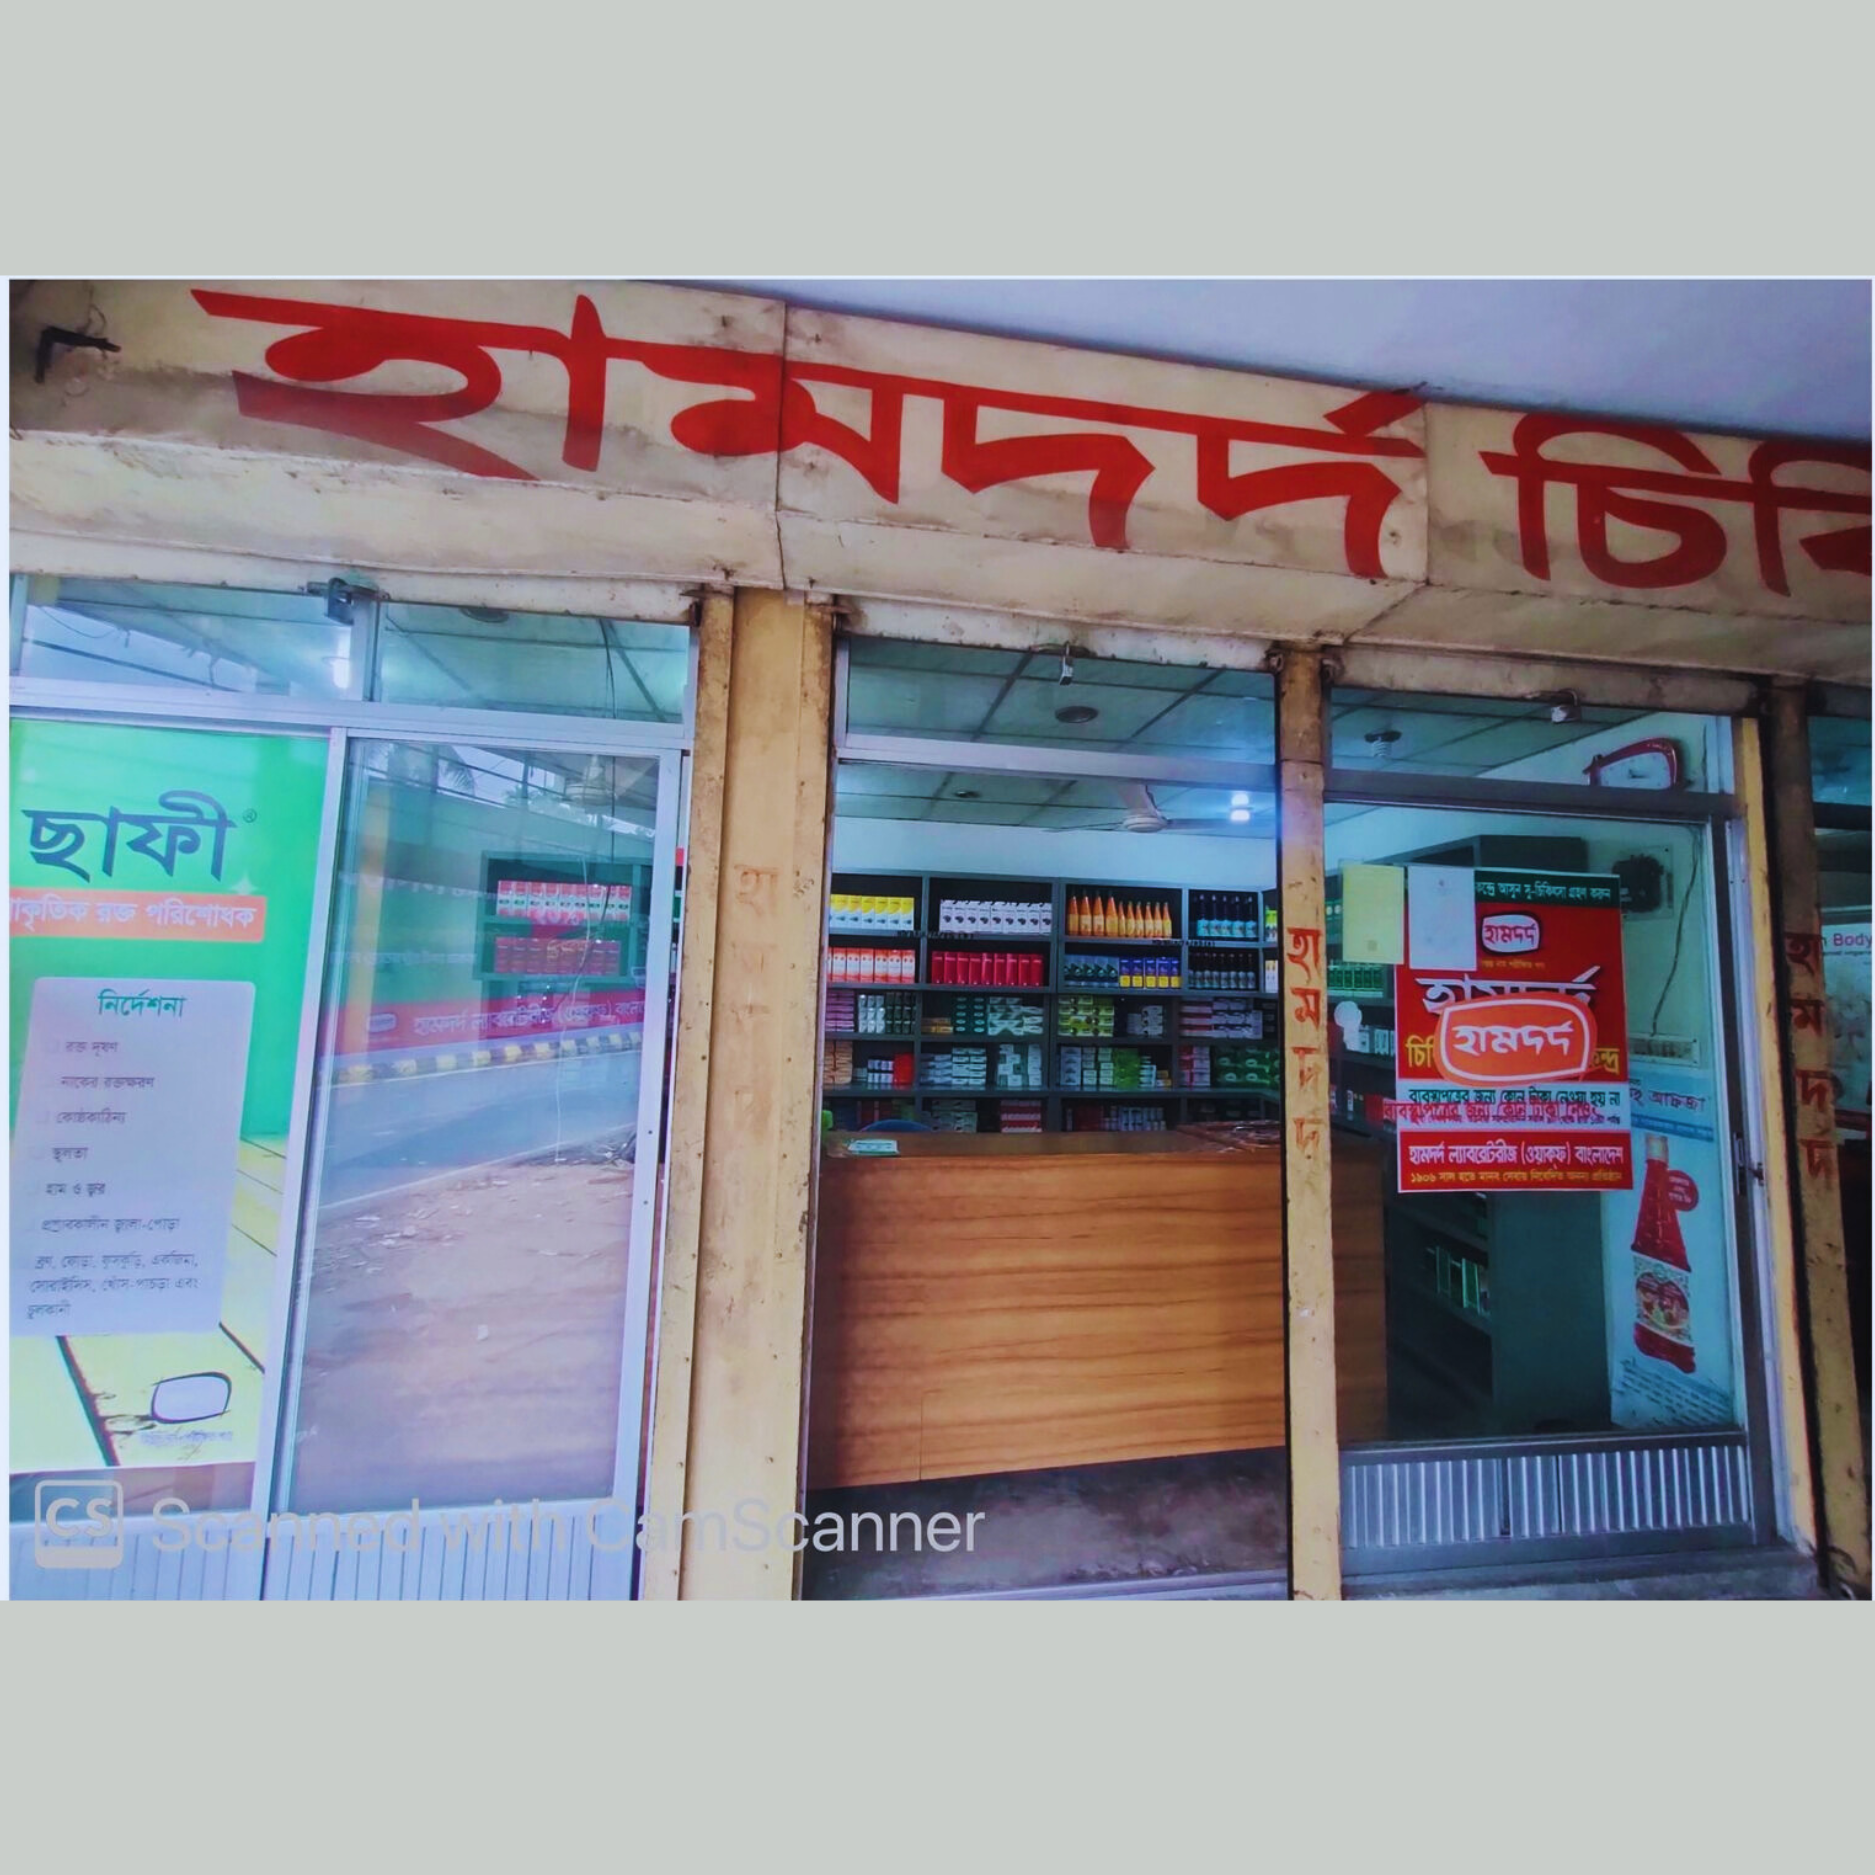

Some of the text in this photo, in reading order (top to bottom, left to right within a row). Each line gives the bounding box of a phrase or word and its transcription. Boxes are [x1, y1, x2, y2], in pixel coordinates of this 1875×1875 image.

[190, 288, 1428, 578] হামদর্দ
[21, 789, 237, 883] ছাফী
[9, 893, 258, 932] াকৃতিক রক্ত পরিশোধক
[1484, 923, 1537, 945] হামদর্দ
[98, 988, 187, 1017] নির্দেশনা
[1452, 1020, 1574, 1056] হামদর্দ
[1409, 1142, 1445, 1165] হামদর্দ
[1575, 1146, 1624, 1165] বাংলাদেশ
